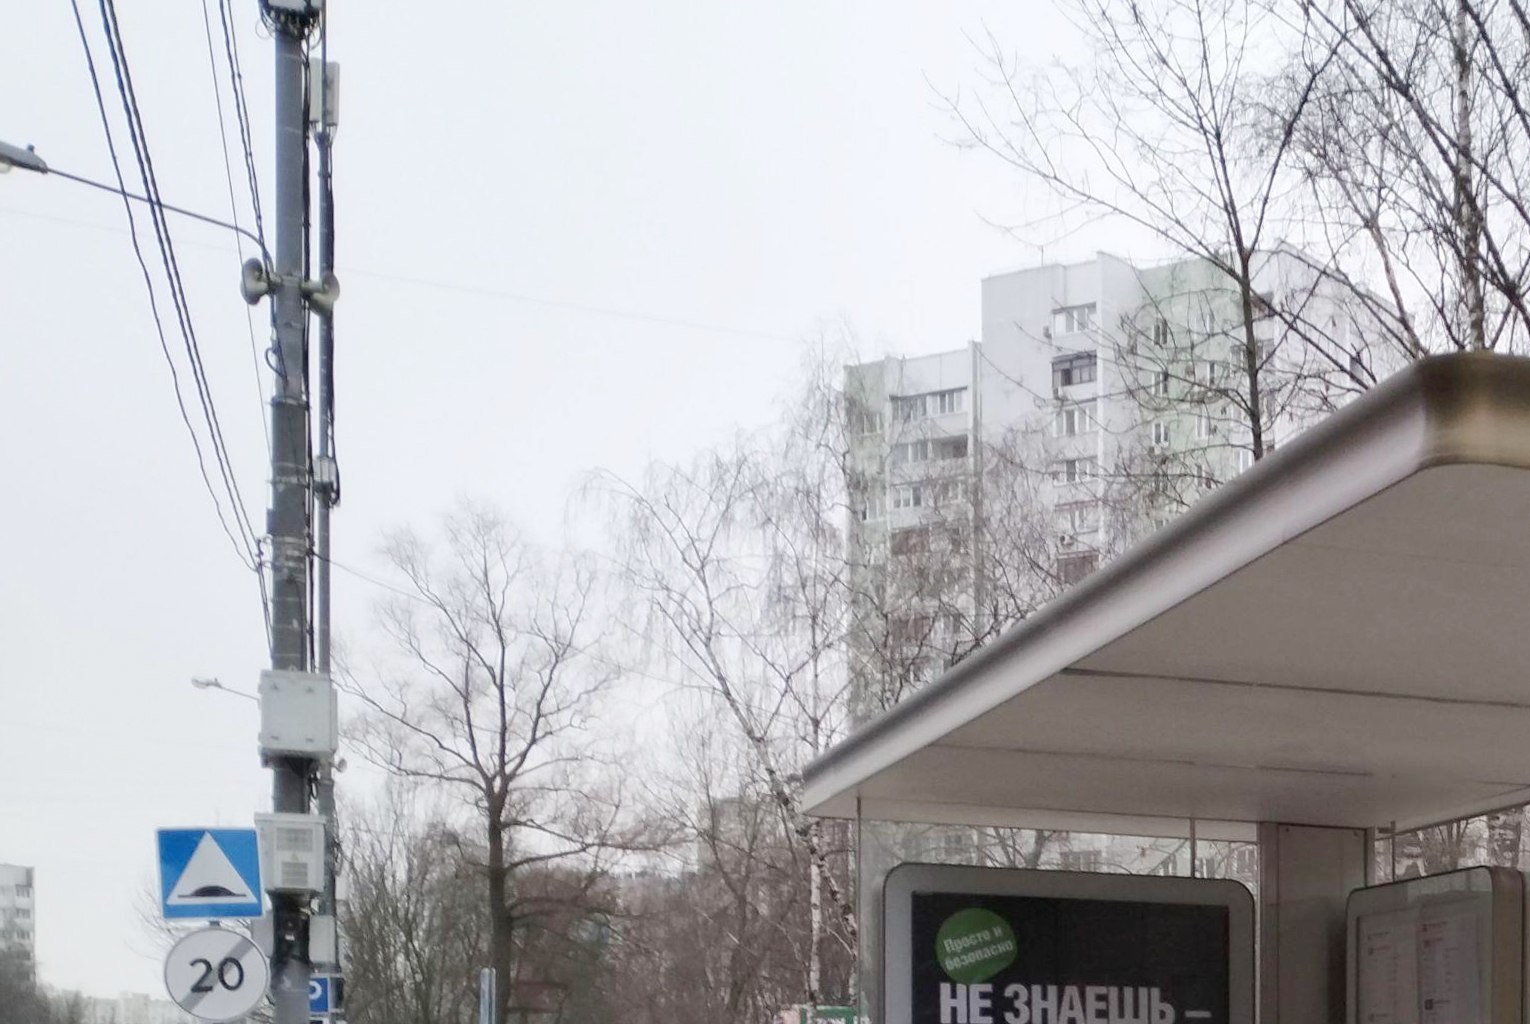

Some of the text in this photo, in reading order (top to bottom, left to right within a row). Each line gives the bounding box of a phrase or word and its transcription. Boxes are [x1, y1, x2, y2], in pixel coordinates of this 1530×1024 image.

[943, 929, 991, 953] Просто
[945, 939, 1014, 971] безопасно
[189, 956, 245, 994] 20
[939, 982, 994, 1024] НЕ
